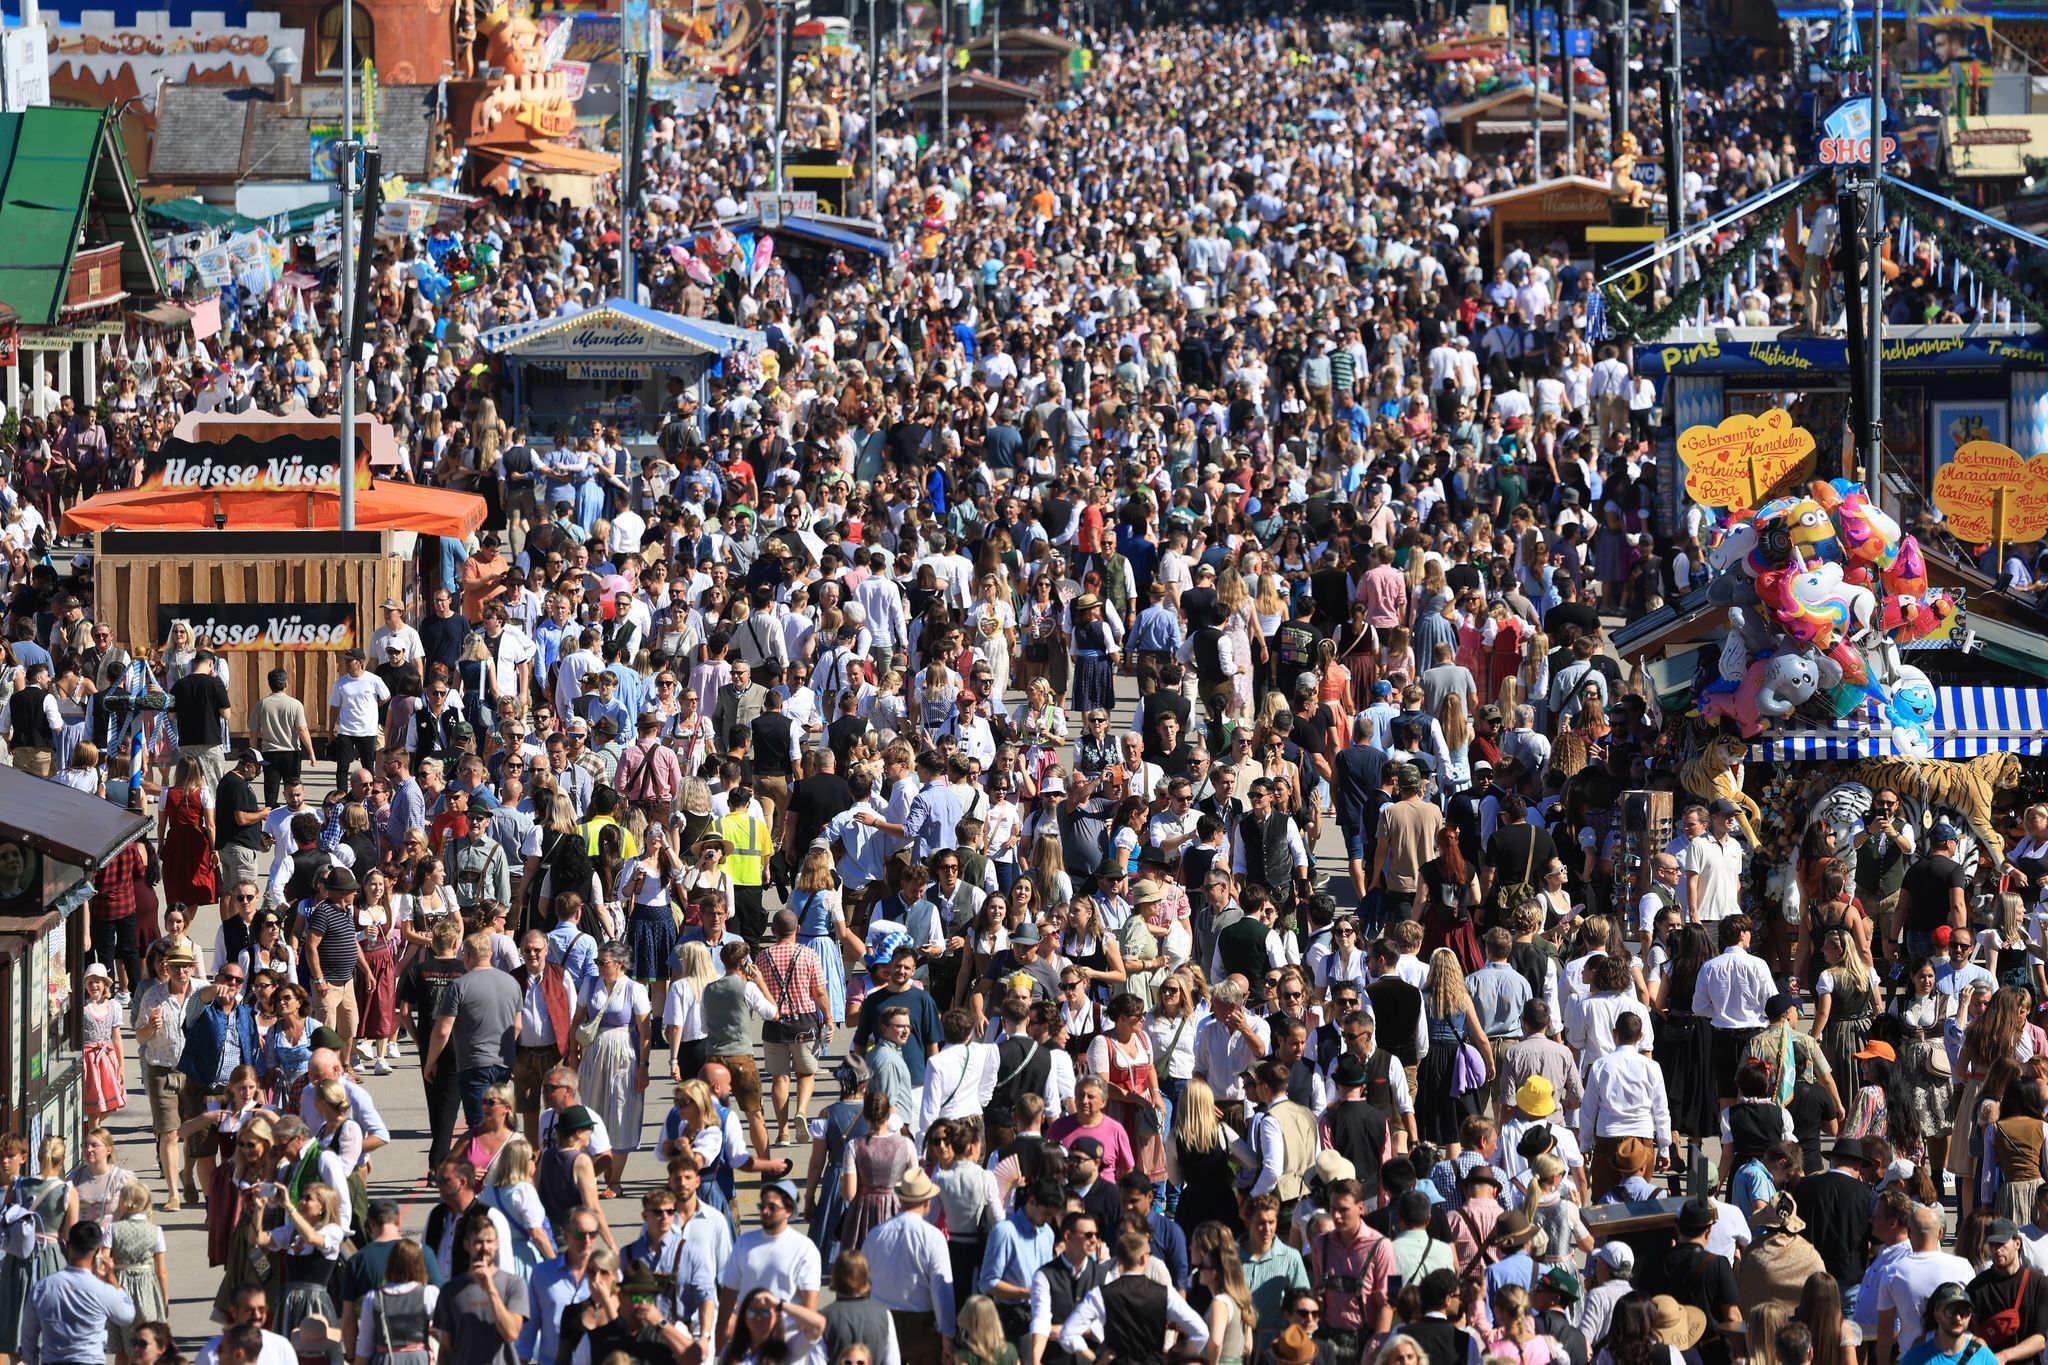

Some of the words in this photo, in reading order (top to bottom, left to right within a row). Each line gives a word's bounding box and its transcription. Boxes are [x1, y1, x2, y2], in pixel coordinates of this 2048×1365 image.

[572, 330, 645, 349] Mandeln
[1661, 341, 1720, 373] Pins
[1748, 341, 1814, 369] Halstücher
[1987, 340, 2045, 363] Tassen
[579, 366, 640, 380] Mandeln
[1687, 424, 1761, 450] Gebrannte
[1739, 432, 1806, 457] Mandeln
[1957, 450, 2020, 469] Gebrannte
[162, 457, 259, 487] Heisse
[1943, 466, 2024, 483] Macadamia
[1699, 480, 1740, 500] Para
[1949, 513, 1991, 536] Kürbis
[171, 617, 260, 646] eisse
[263, 615, 347, 646] Nüsse
